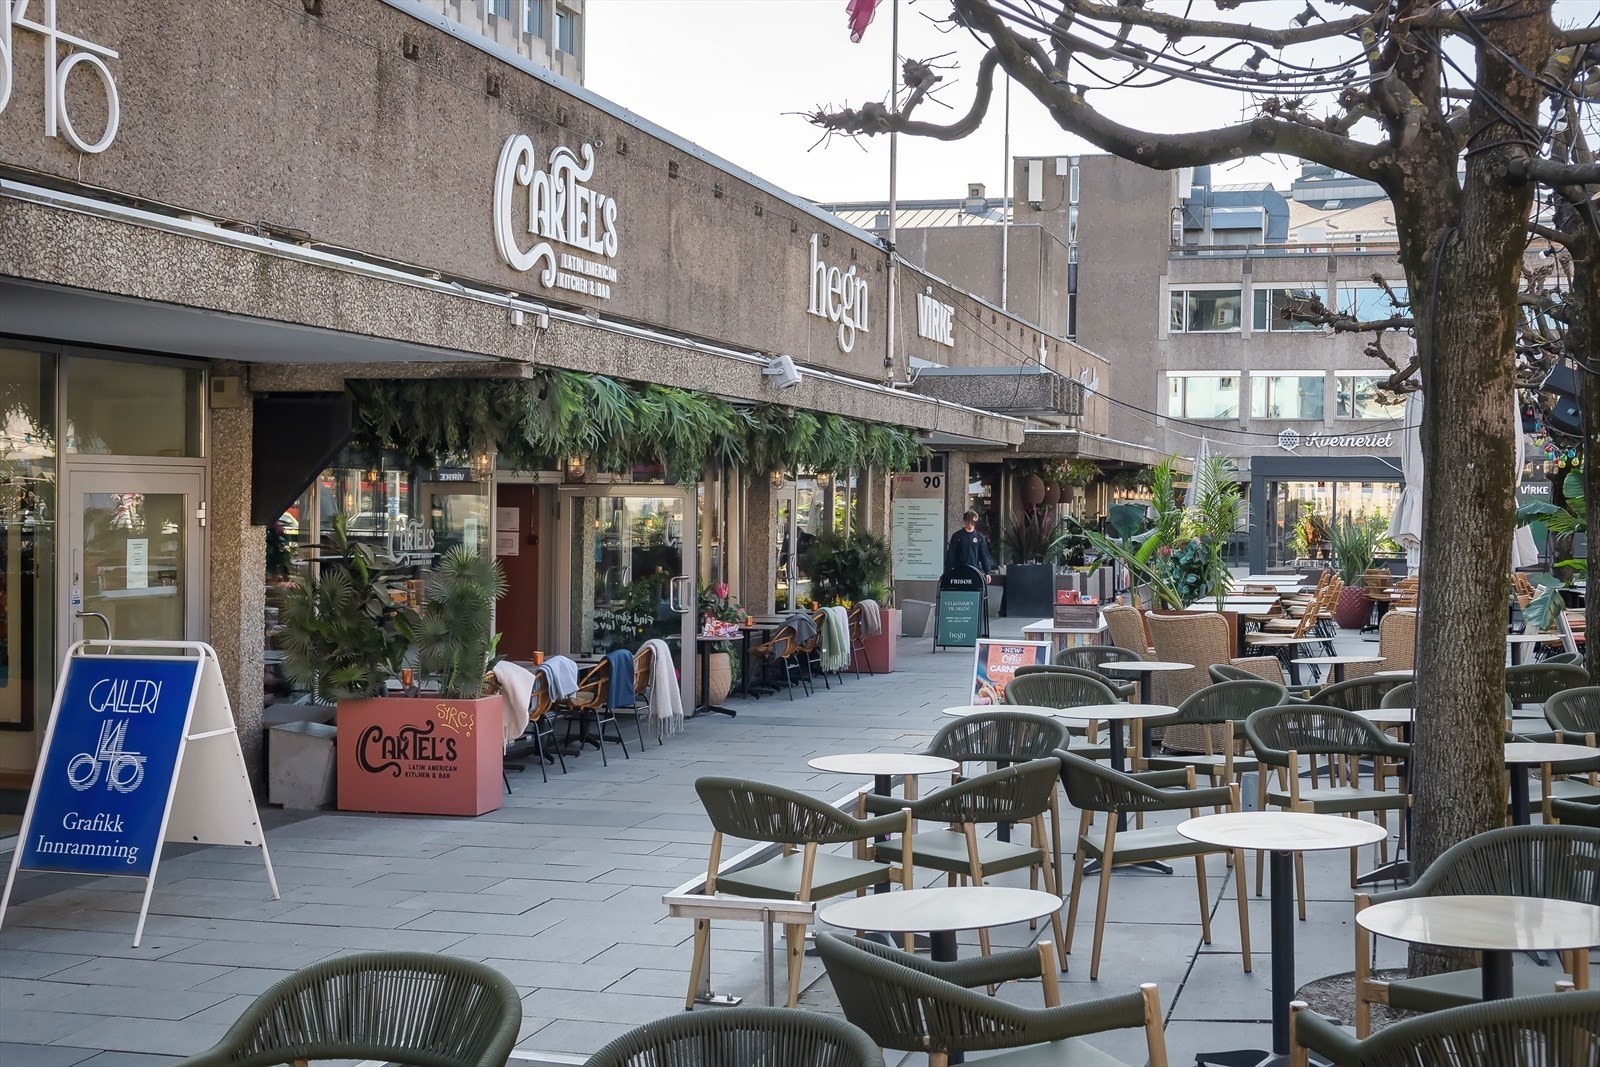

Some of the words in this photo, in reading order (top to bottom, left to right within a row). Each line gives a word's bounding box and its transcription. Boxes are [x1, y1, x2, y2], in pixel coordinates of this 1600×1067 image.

[561, 254, 584, 275] LATIN
[586, 260, 617, 283] AMERICAN
[557, 273, 588, 294] KITCHEN
[807, 233, 869, 353] hegn
[1306, 432, 1393, 448] Kverneriet
[923, 476, 940, 488] 90
[89, 678, 162, 714] GALLERI
[356, 719, 457, 778] CARTEL'S
[62, 812, 124, 833] Grafikk
[36, 835, 139, 864] Innramming
